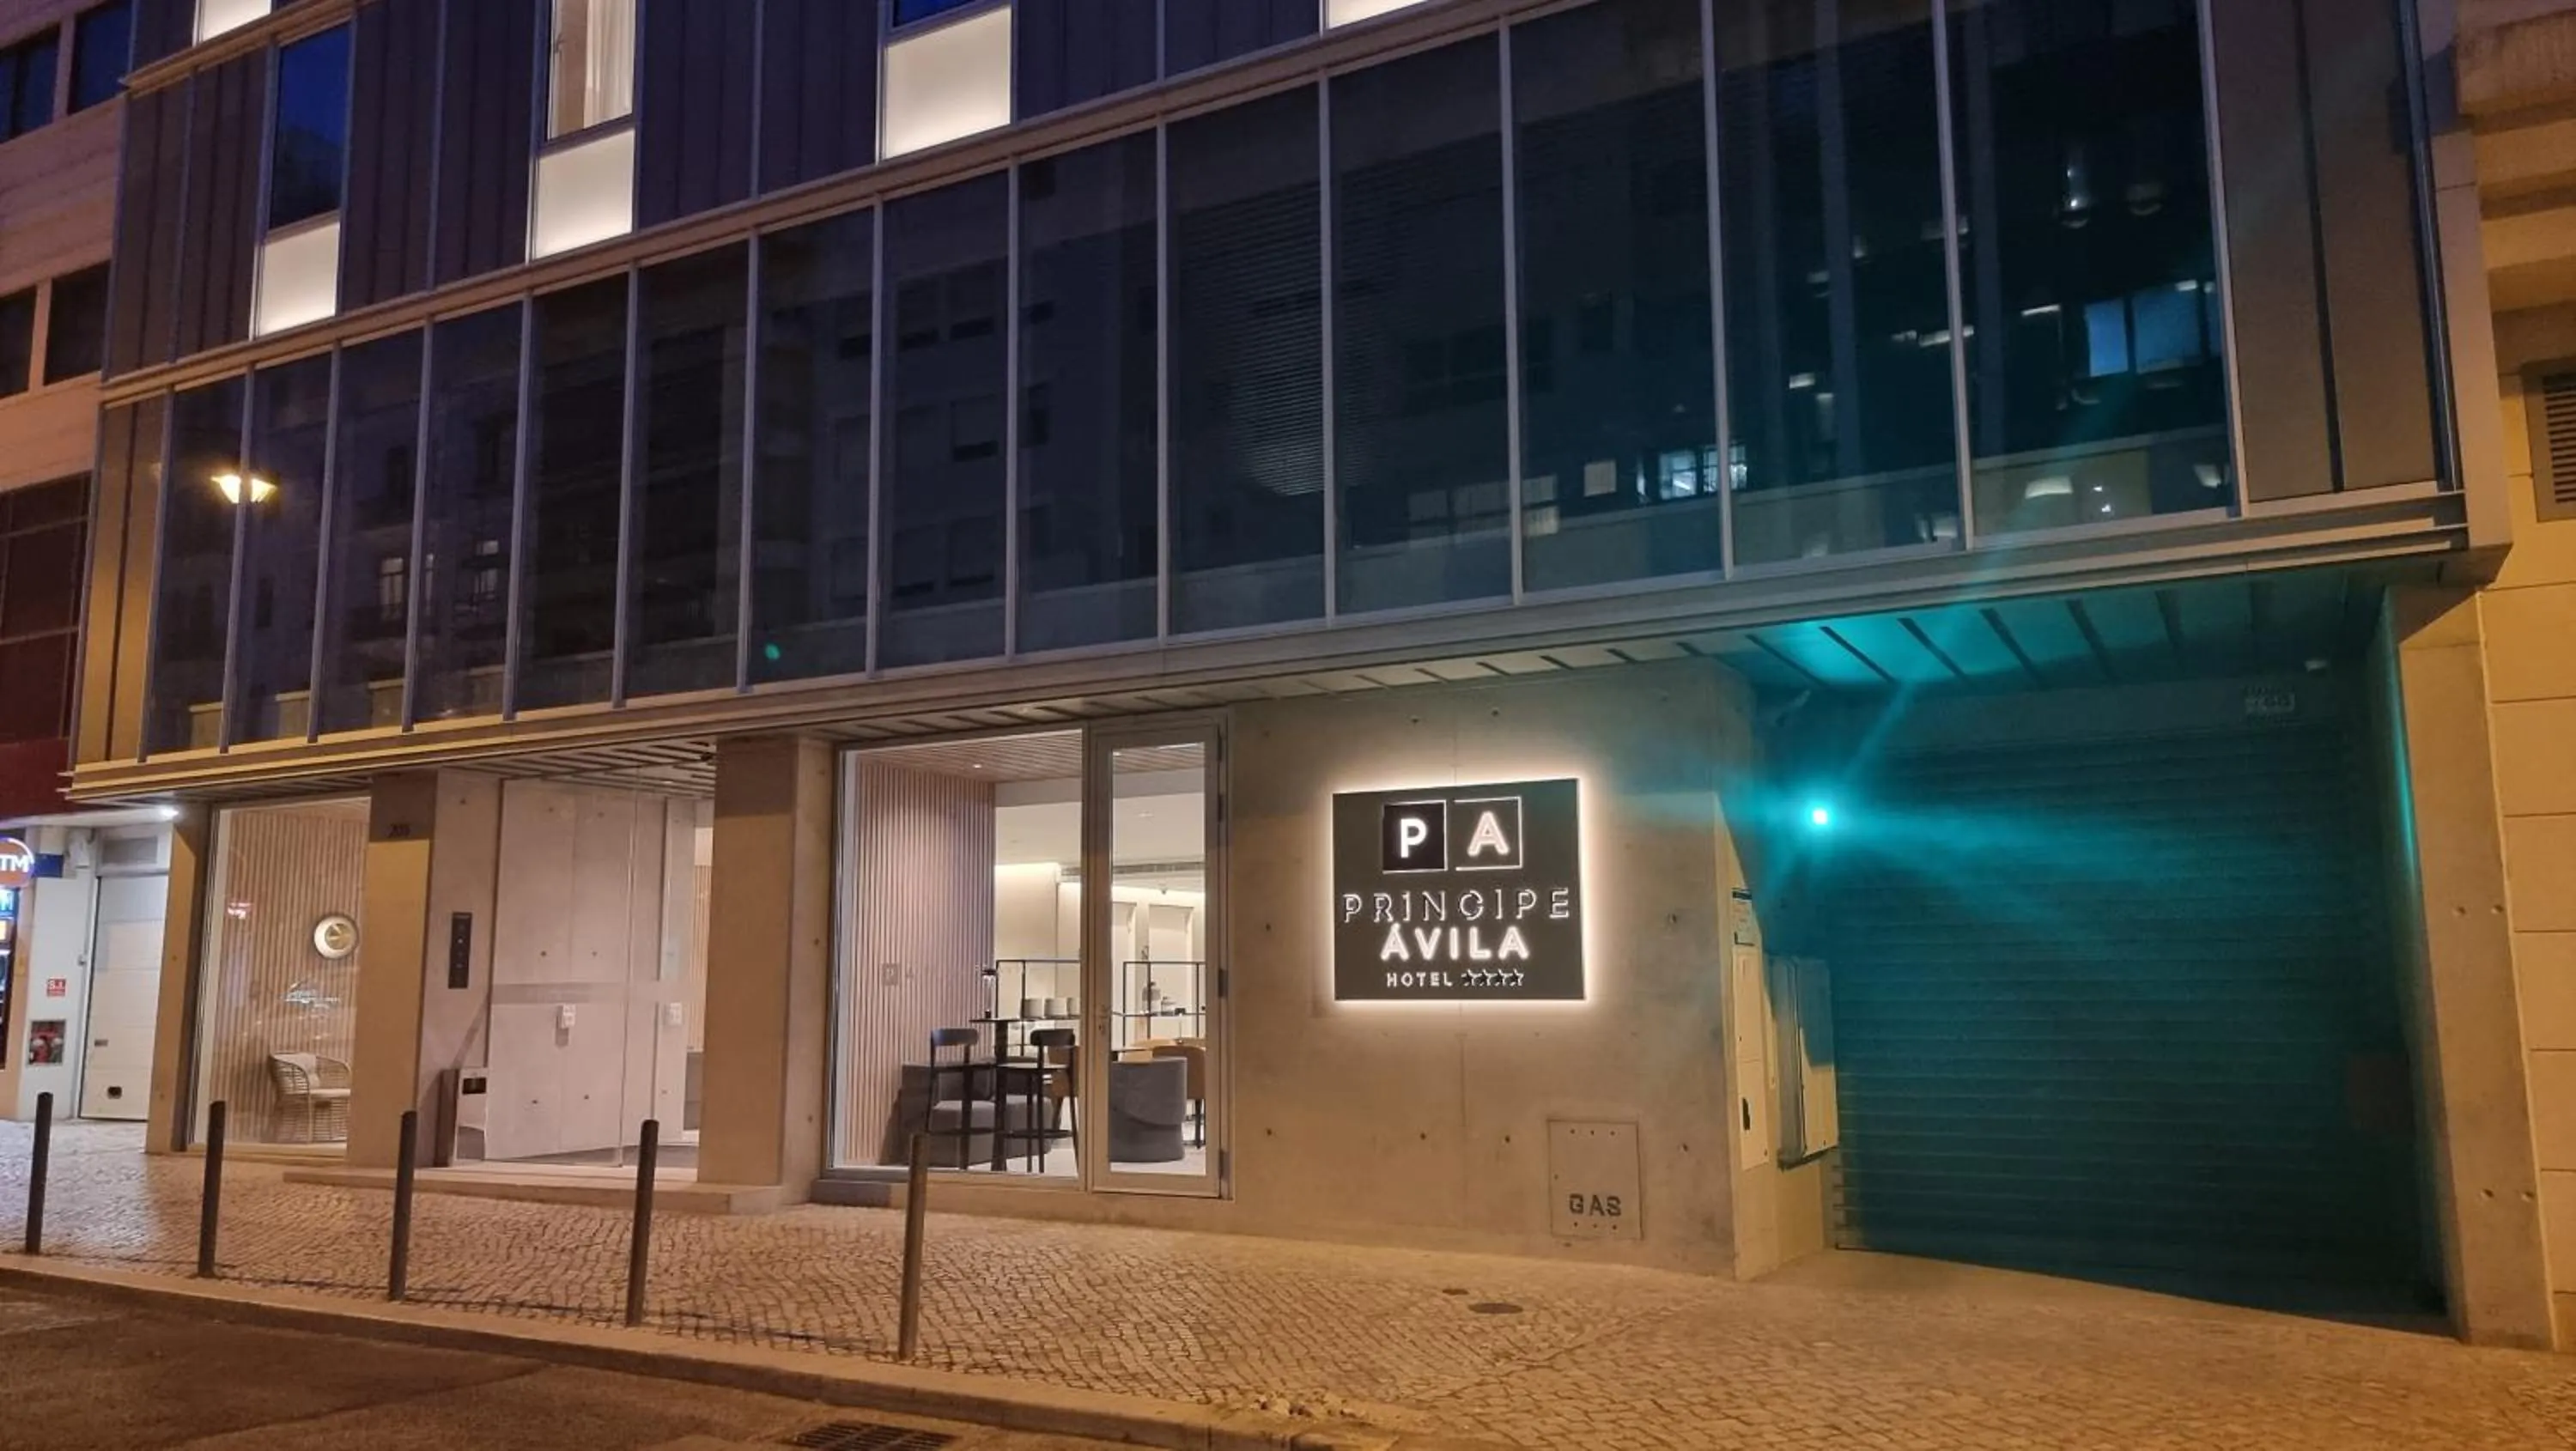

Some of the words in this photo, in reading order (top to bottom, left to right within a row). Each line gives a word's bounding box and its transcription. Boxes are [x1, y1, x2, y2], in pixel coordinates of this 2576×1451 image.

[1400, 818, 1427, 858] P
[1467, 811, 1510, 856] A
[1343, 888, 1570, 923] PRINCIPE
[1380, 922, 1529, 961] ÁVILA
[1387, 972, 1453, 987] HOTEL
[1568, 1193, 1622, 1217] GAS
